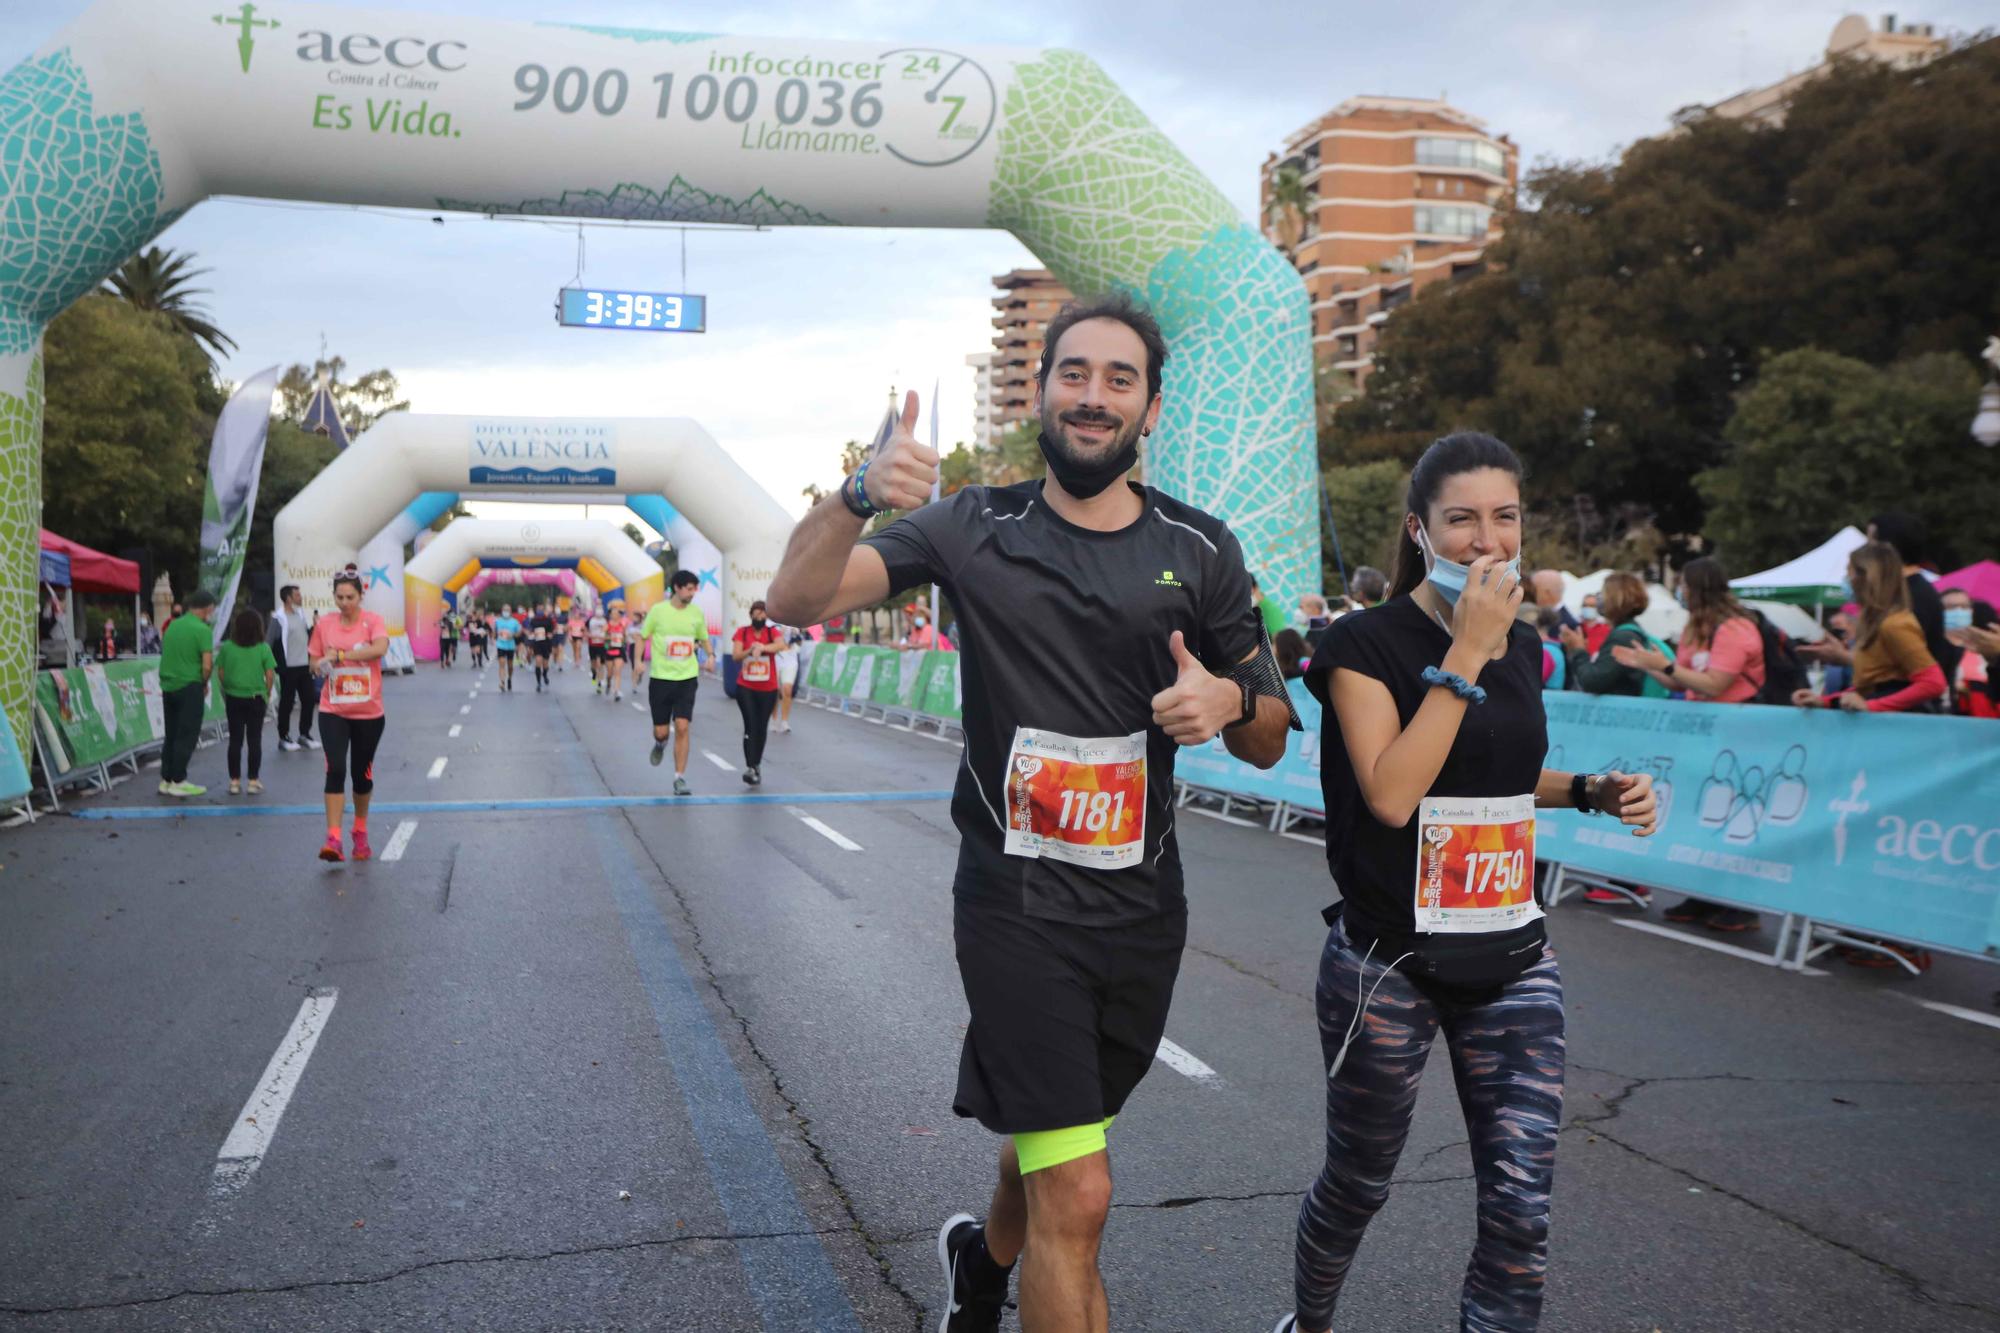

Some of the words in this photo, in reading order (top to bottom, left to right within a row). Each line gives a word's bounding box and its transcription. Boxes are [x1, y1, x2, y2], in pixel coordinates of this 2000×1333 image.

[296, 30, 468, 72] aecc
[708, 51, 886, 80] infocáncer
[902, 54, 942, 74] 24
[327, 69, 374, 87] Contra
[378, 72, 390, 87] el
[394, 74, 439, 91] Cáncer
[513, 63, 629, 117] 900
[653, 72, 759, 123] 100
[774, 78, 883, 128] 036
[312, 93, 352, 130] Es
[366, 97, 461, 138] Vida.
[938, 96, 967, 133] 7
[741, 121, 881, 154] Llámame.
[585, 291, 683, 329] 3:39:3
[586, 427, 609, 436] DE
[1059, 789, 1126, 832] 1181
[1876, 815, 2000, 871] aecc
[1464, 848, 1525, 894] 1750
